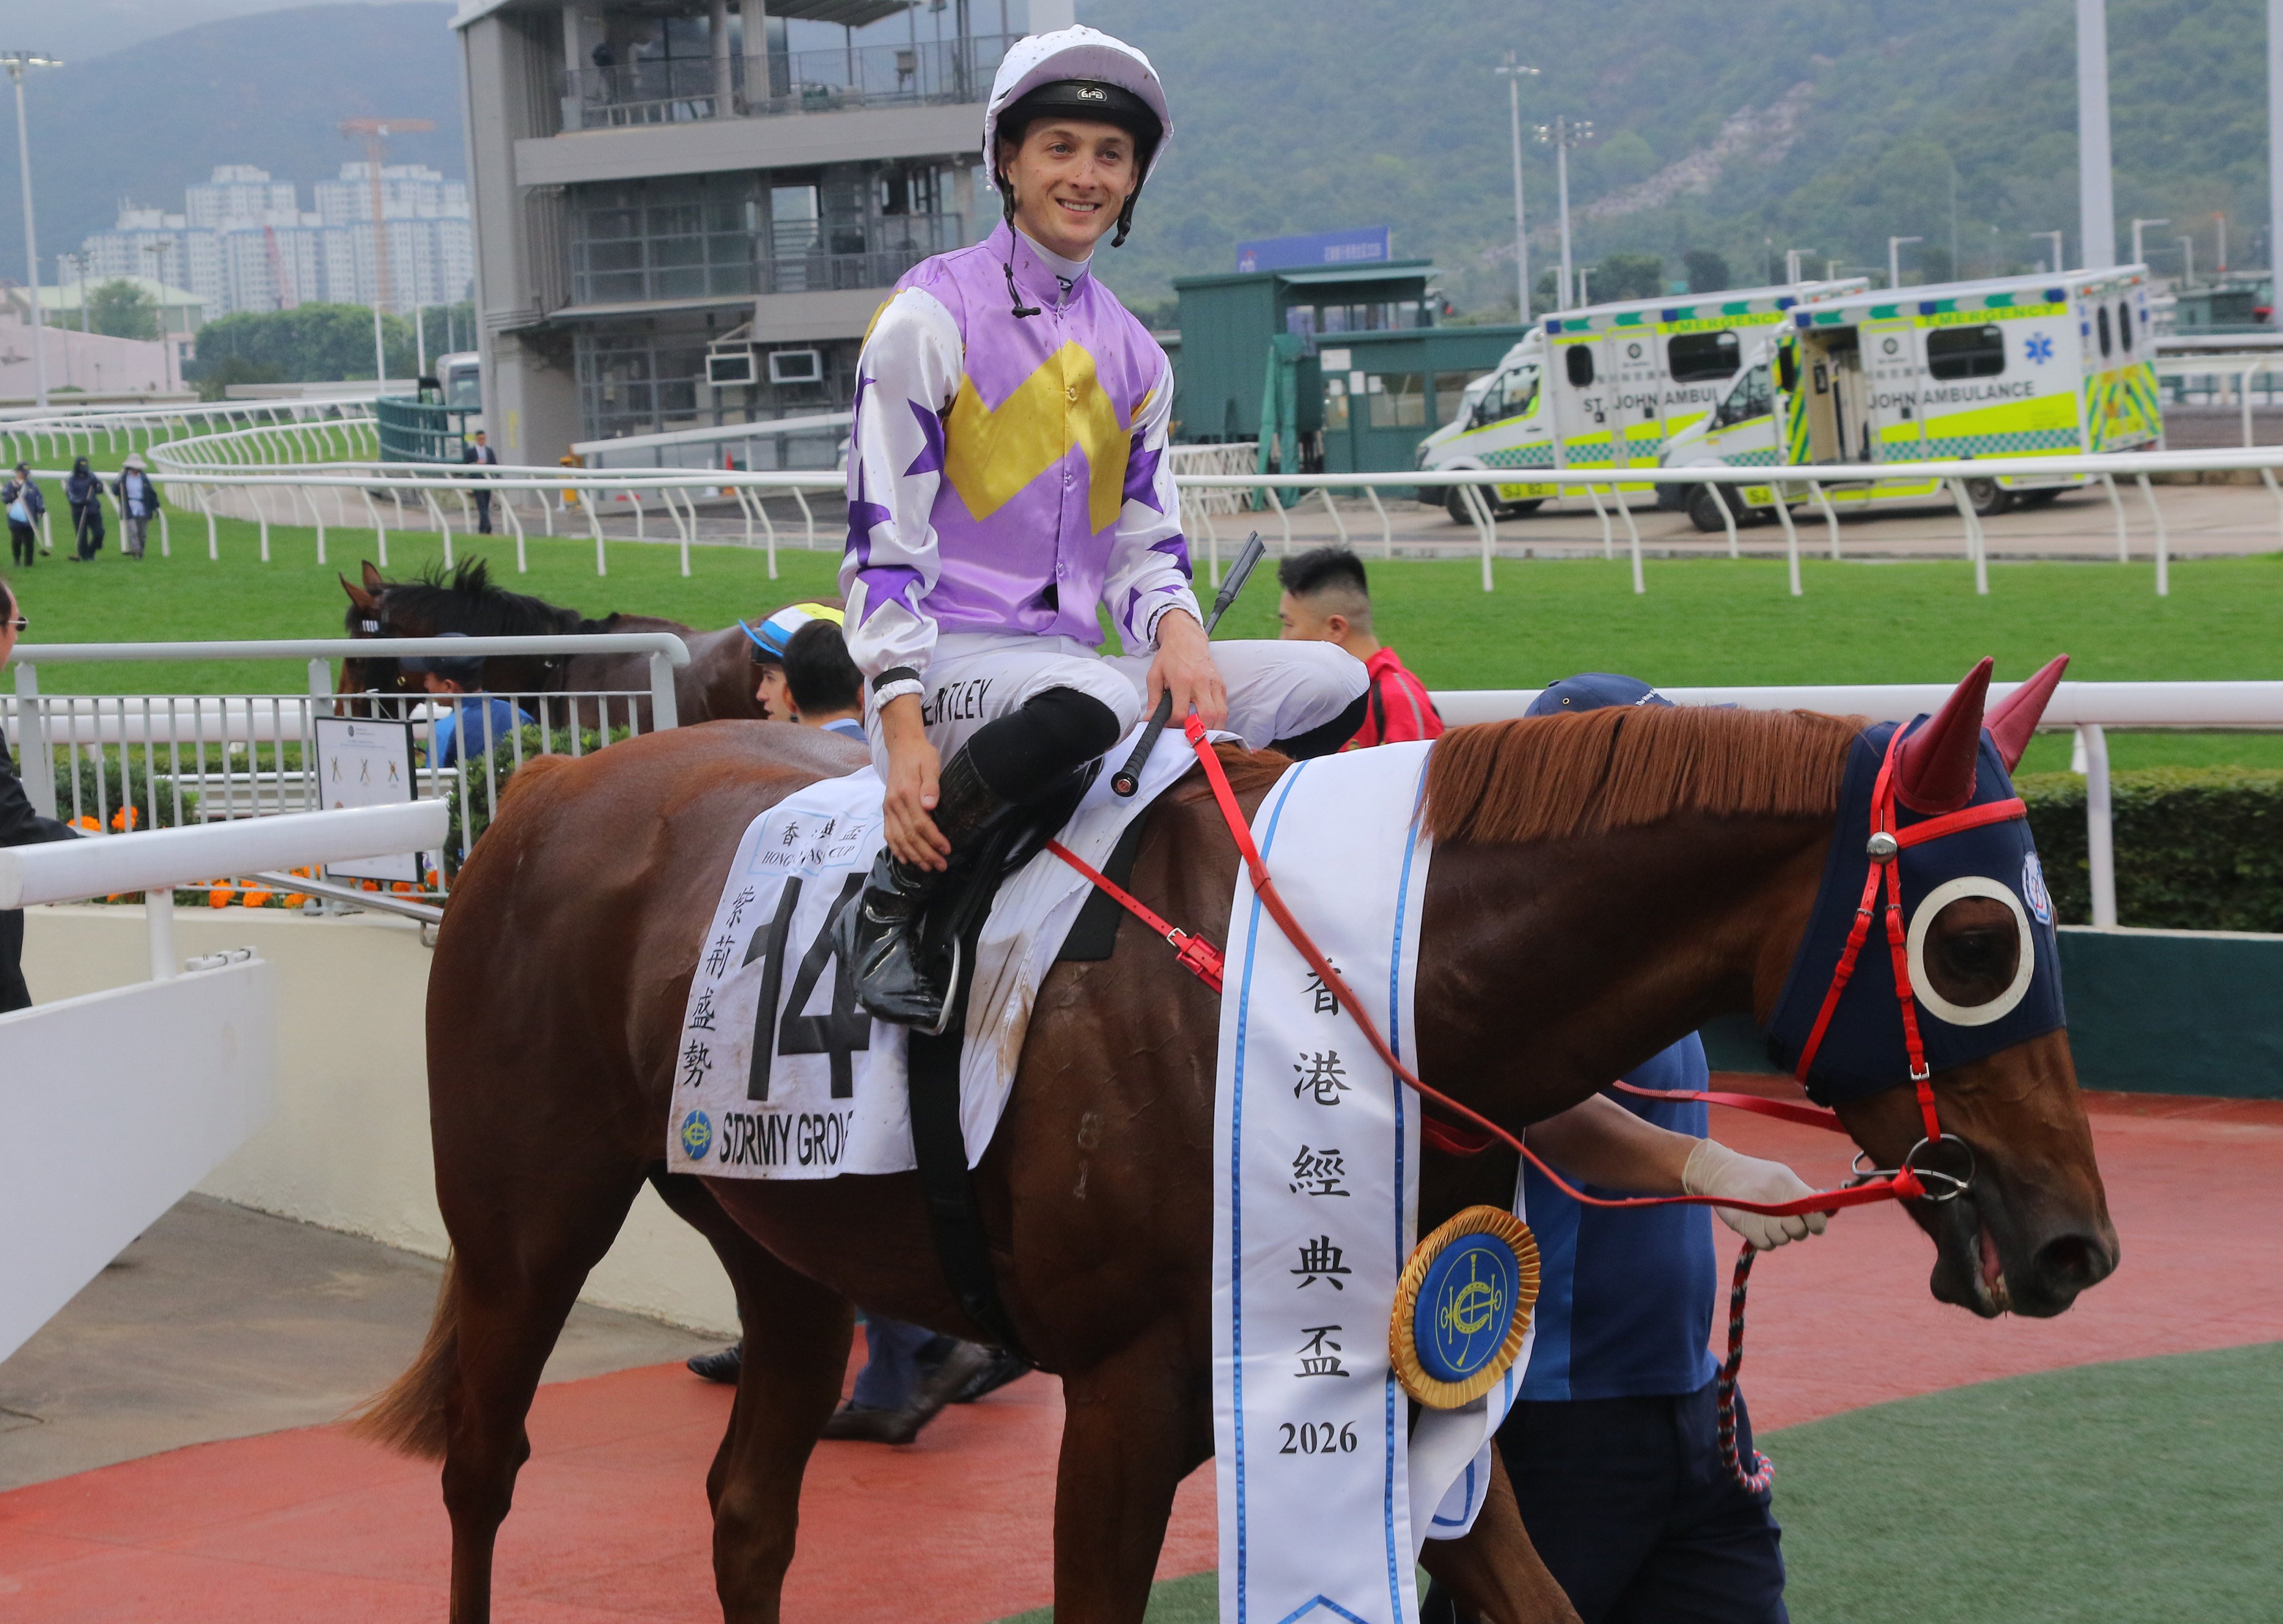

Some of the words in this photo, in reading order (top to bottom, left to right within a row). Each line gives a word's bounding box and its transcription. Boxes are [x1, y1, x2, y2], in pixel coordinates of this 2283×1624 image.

[1668, 312, 1783, 333] EMERGENCY
[1926, 307, 2052, 326] EMERGENCY
[1615, 394, 1658, 409] JOHN
[1869, 391, 1916, 409] JOHN
[1923, 381, 2034, 404] AMBULANCE
[922, 678, 993, 726] ENTLEY
[828, 846, 855, 857] CUP
[741, 872, 873, 1101] 14
[798, 1110, 854, 1165] GROV
[1279, 1420, 1358, 1455] 2026
